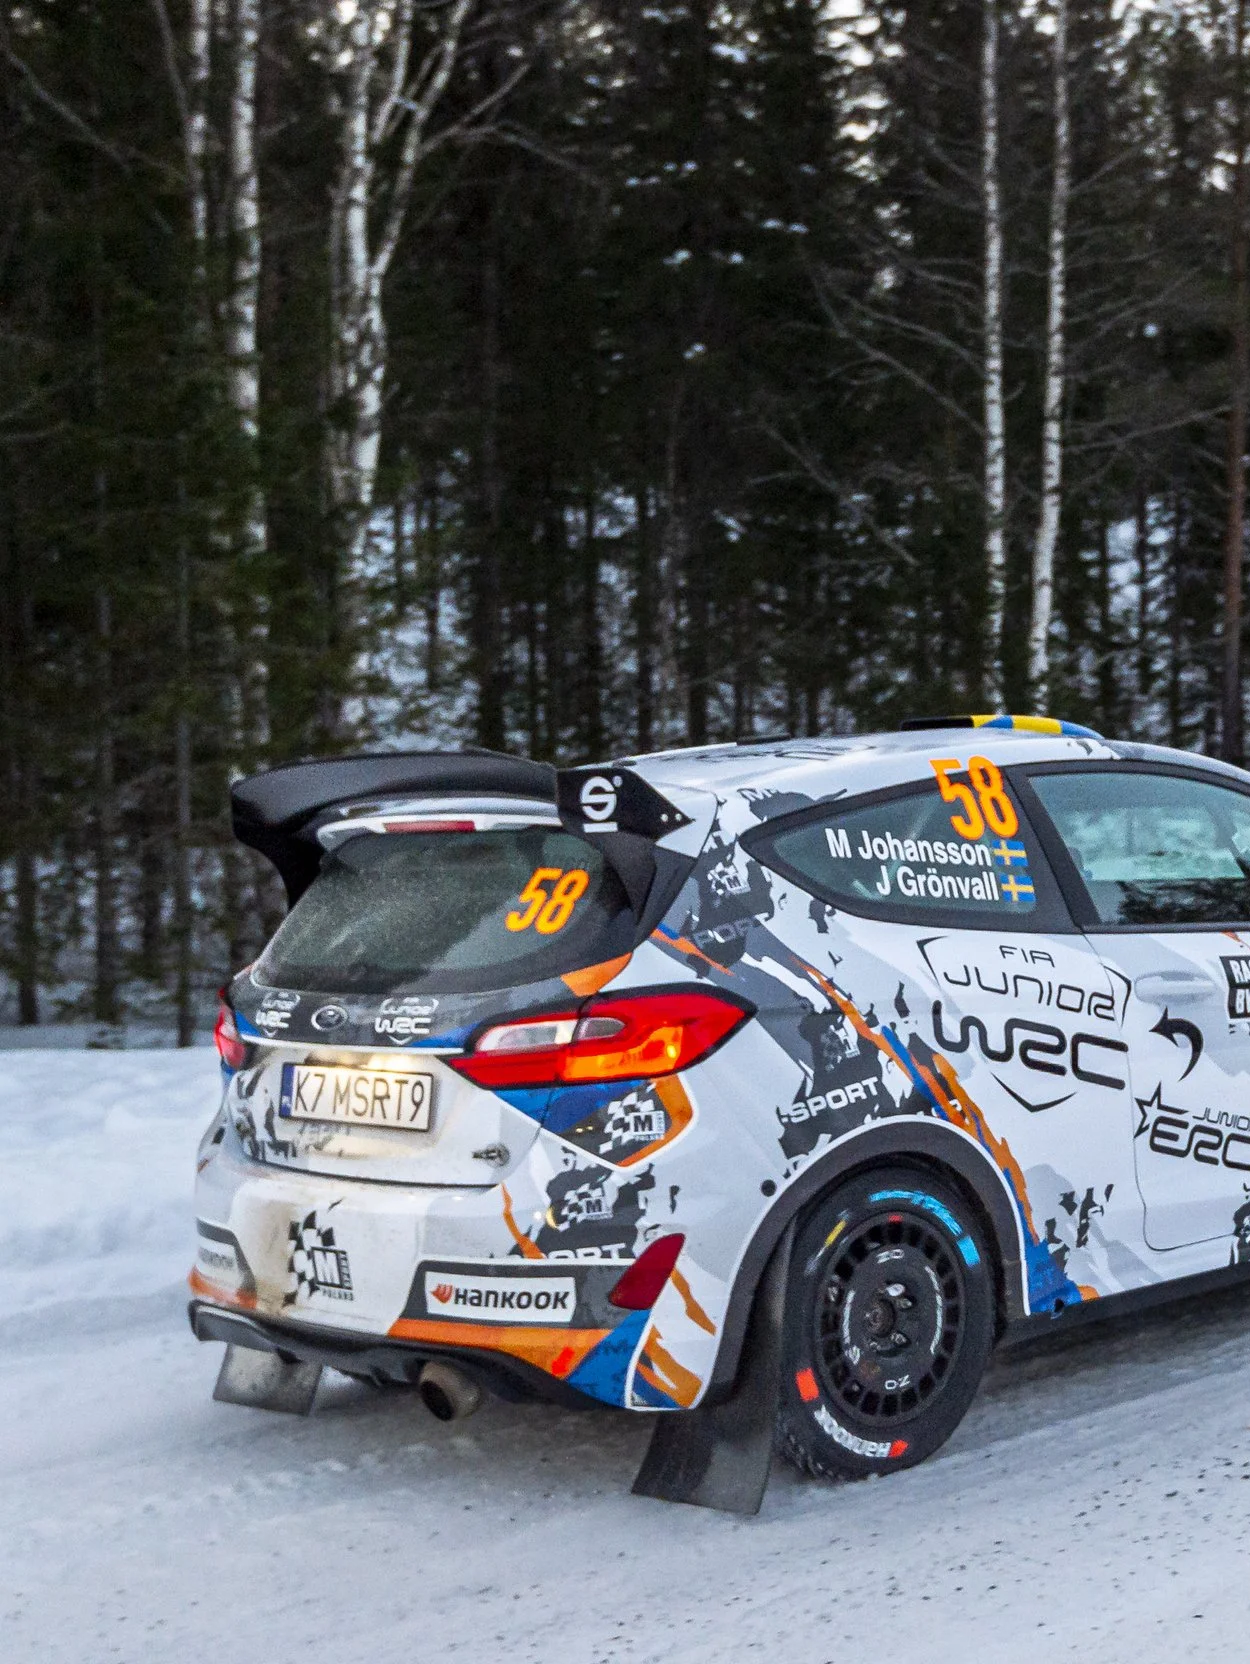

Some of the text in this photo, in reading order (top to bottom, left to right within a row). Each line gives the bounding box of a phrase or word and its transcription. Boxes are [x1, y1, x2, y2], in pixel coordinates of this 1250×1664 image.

[930, 755, 1020, 840] 58
[825, 828, 992, 867] M Johansson
[504, 866, 591, 935] 58
[876, 865, 1000, 901] J Grönvall
[999, 945, 1055, 967] FIA
[943, 965, 1116, 1021] JUNIOR
[375, 1017, 431, 1034] WRC
[932, 1000, 1129, 1091] WRC
[295, 1071, 425, 1122] K7 MSRT9
